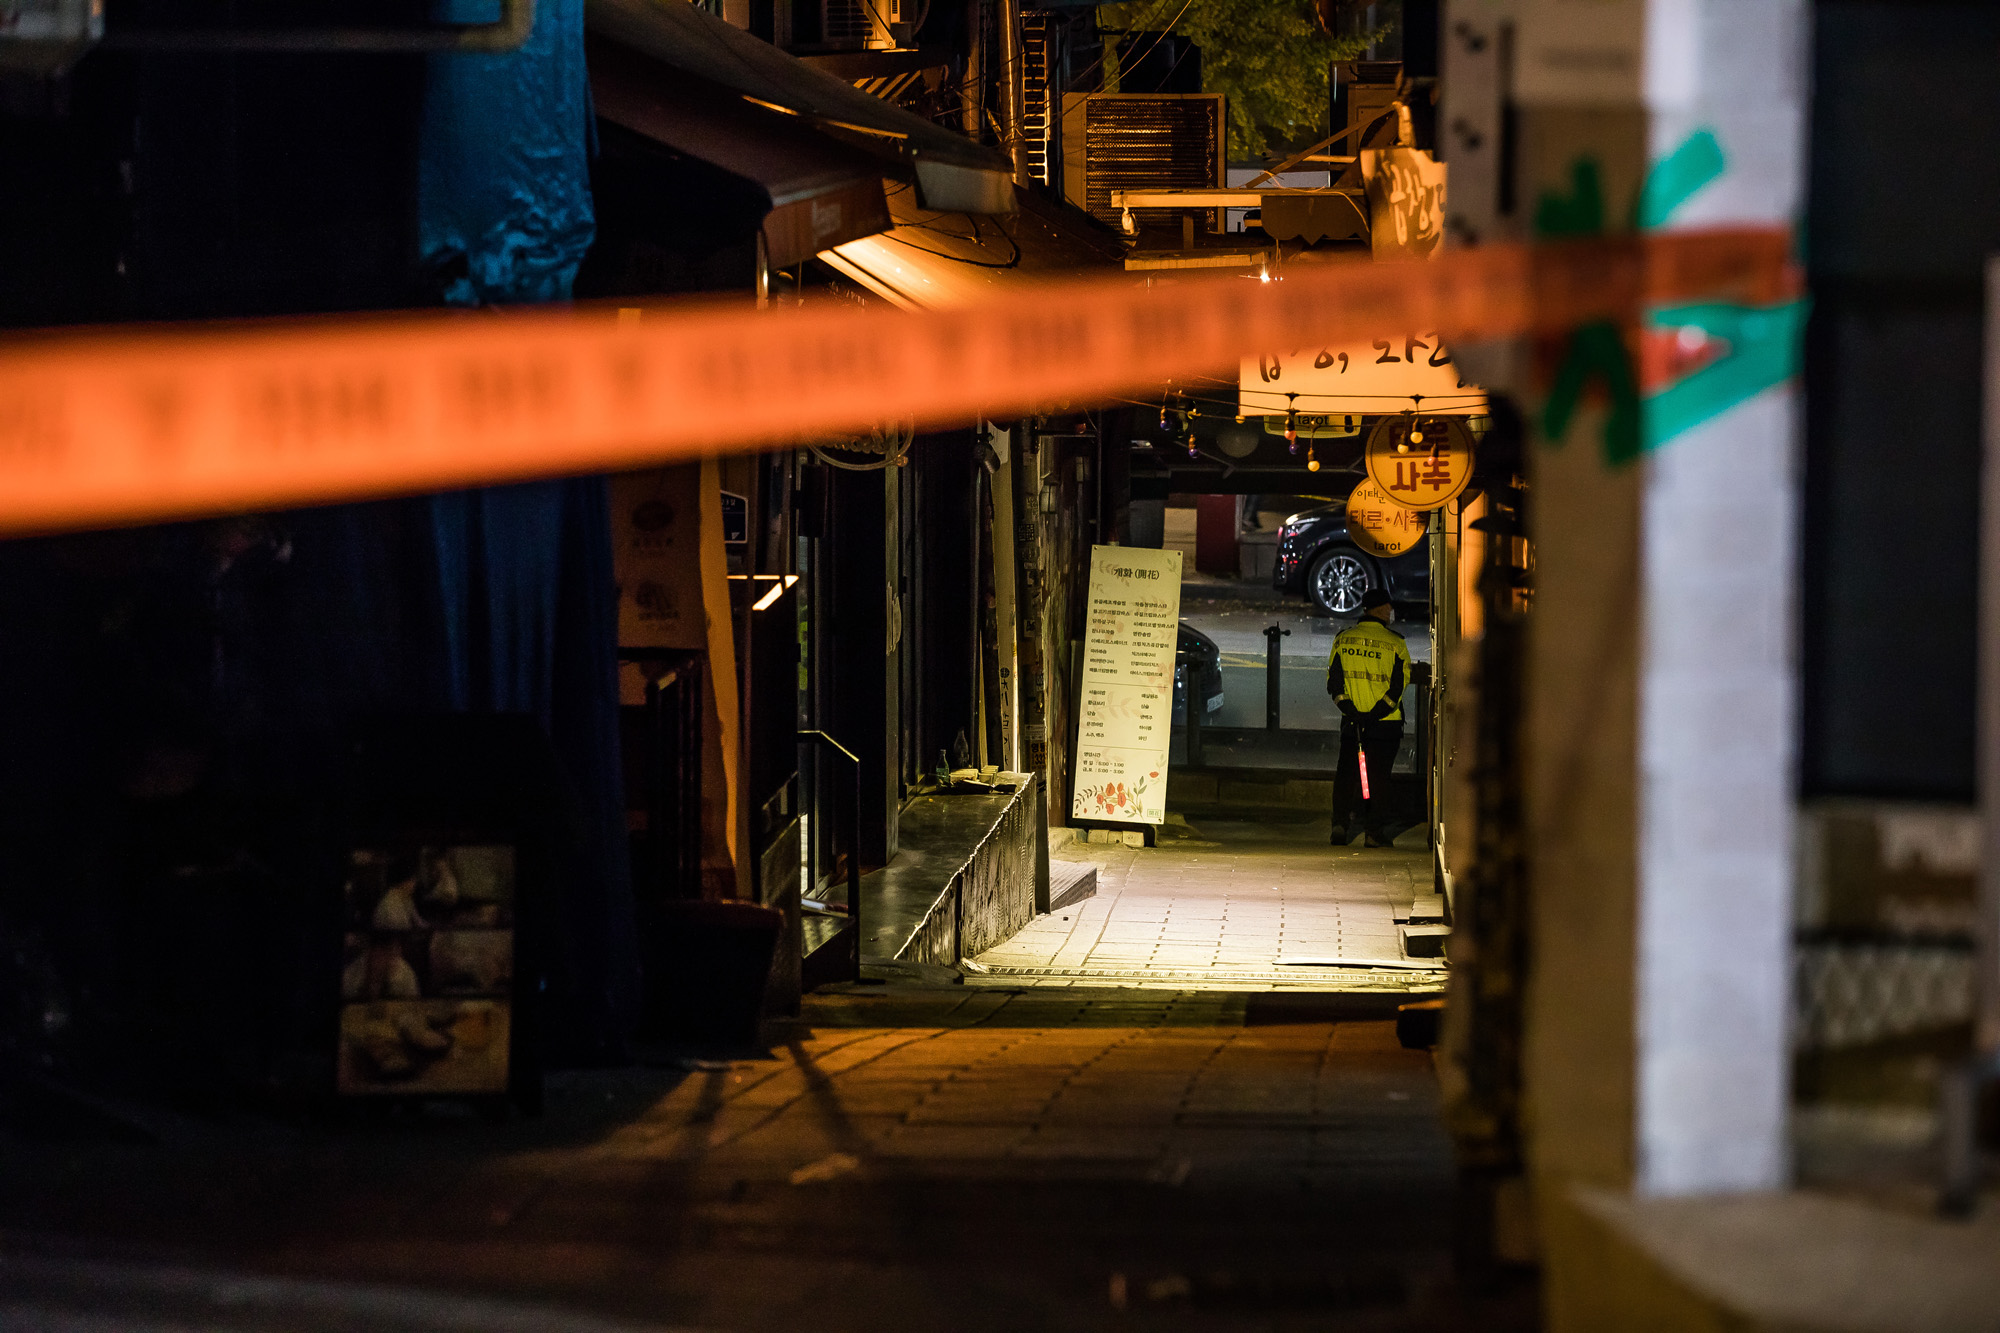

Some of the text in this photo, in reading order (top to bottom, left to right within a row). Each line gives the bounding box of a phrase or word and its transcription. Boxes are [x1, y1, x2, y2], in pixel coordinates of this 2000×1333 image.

[1298, 415, 1328, 425] tarot
[1389, 461, 1452, 492] 사주
[1374, 541, 1401, 551] tarot
[1114, 568, 1133, 578] 개화
[1342, 648, 1382, 659] POLICE
